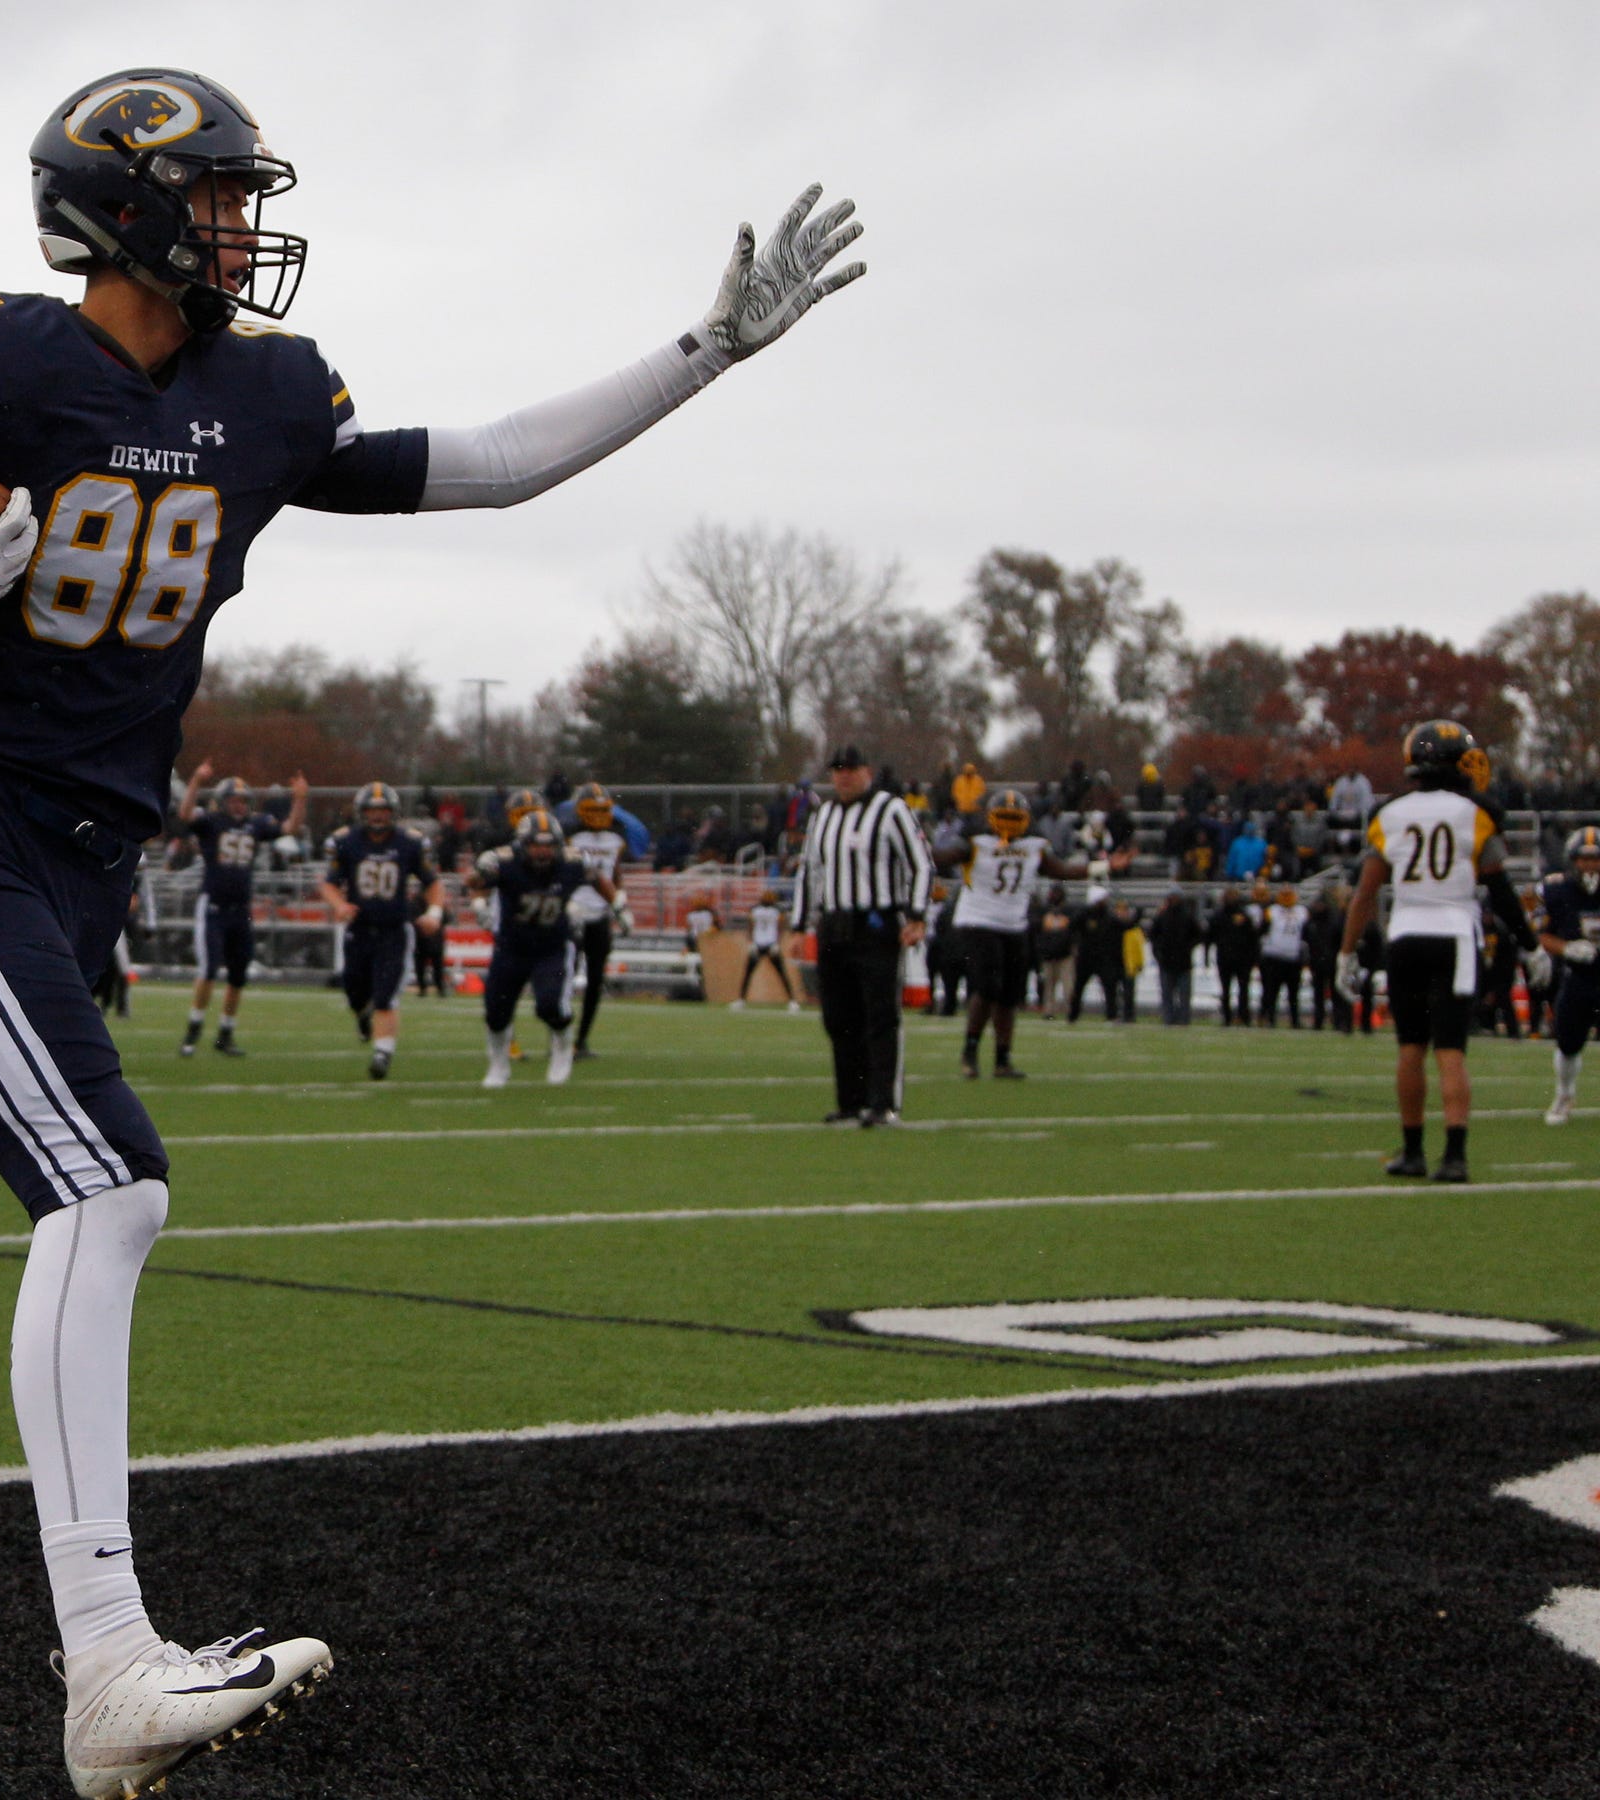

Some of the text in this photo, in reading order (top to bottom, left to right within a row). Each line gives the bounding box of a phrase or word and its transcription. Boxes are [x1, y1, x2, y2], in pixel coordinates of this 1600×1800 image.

[108, 444, 199, 475] DEWITT
[20, 472, 224, 650] 88
[217, 831, 257, 865] 56
[1401, 822, 1456, 882] 20
[356, 859, 400, 900] 60
